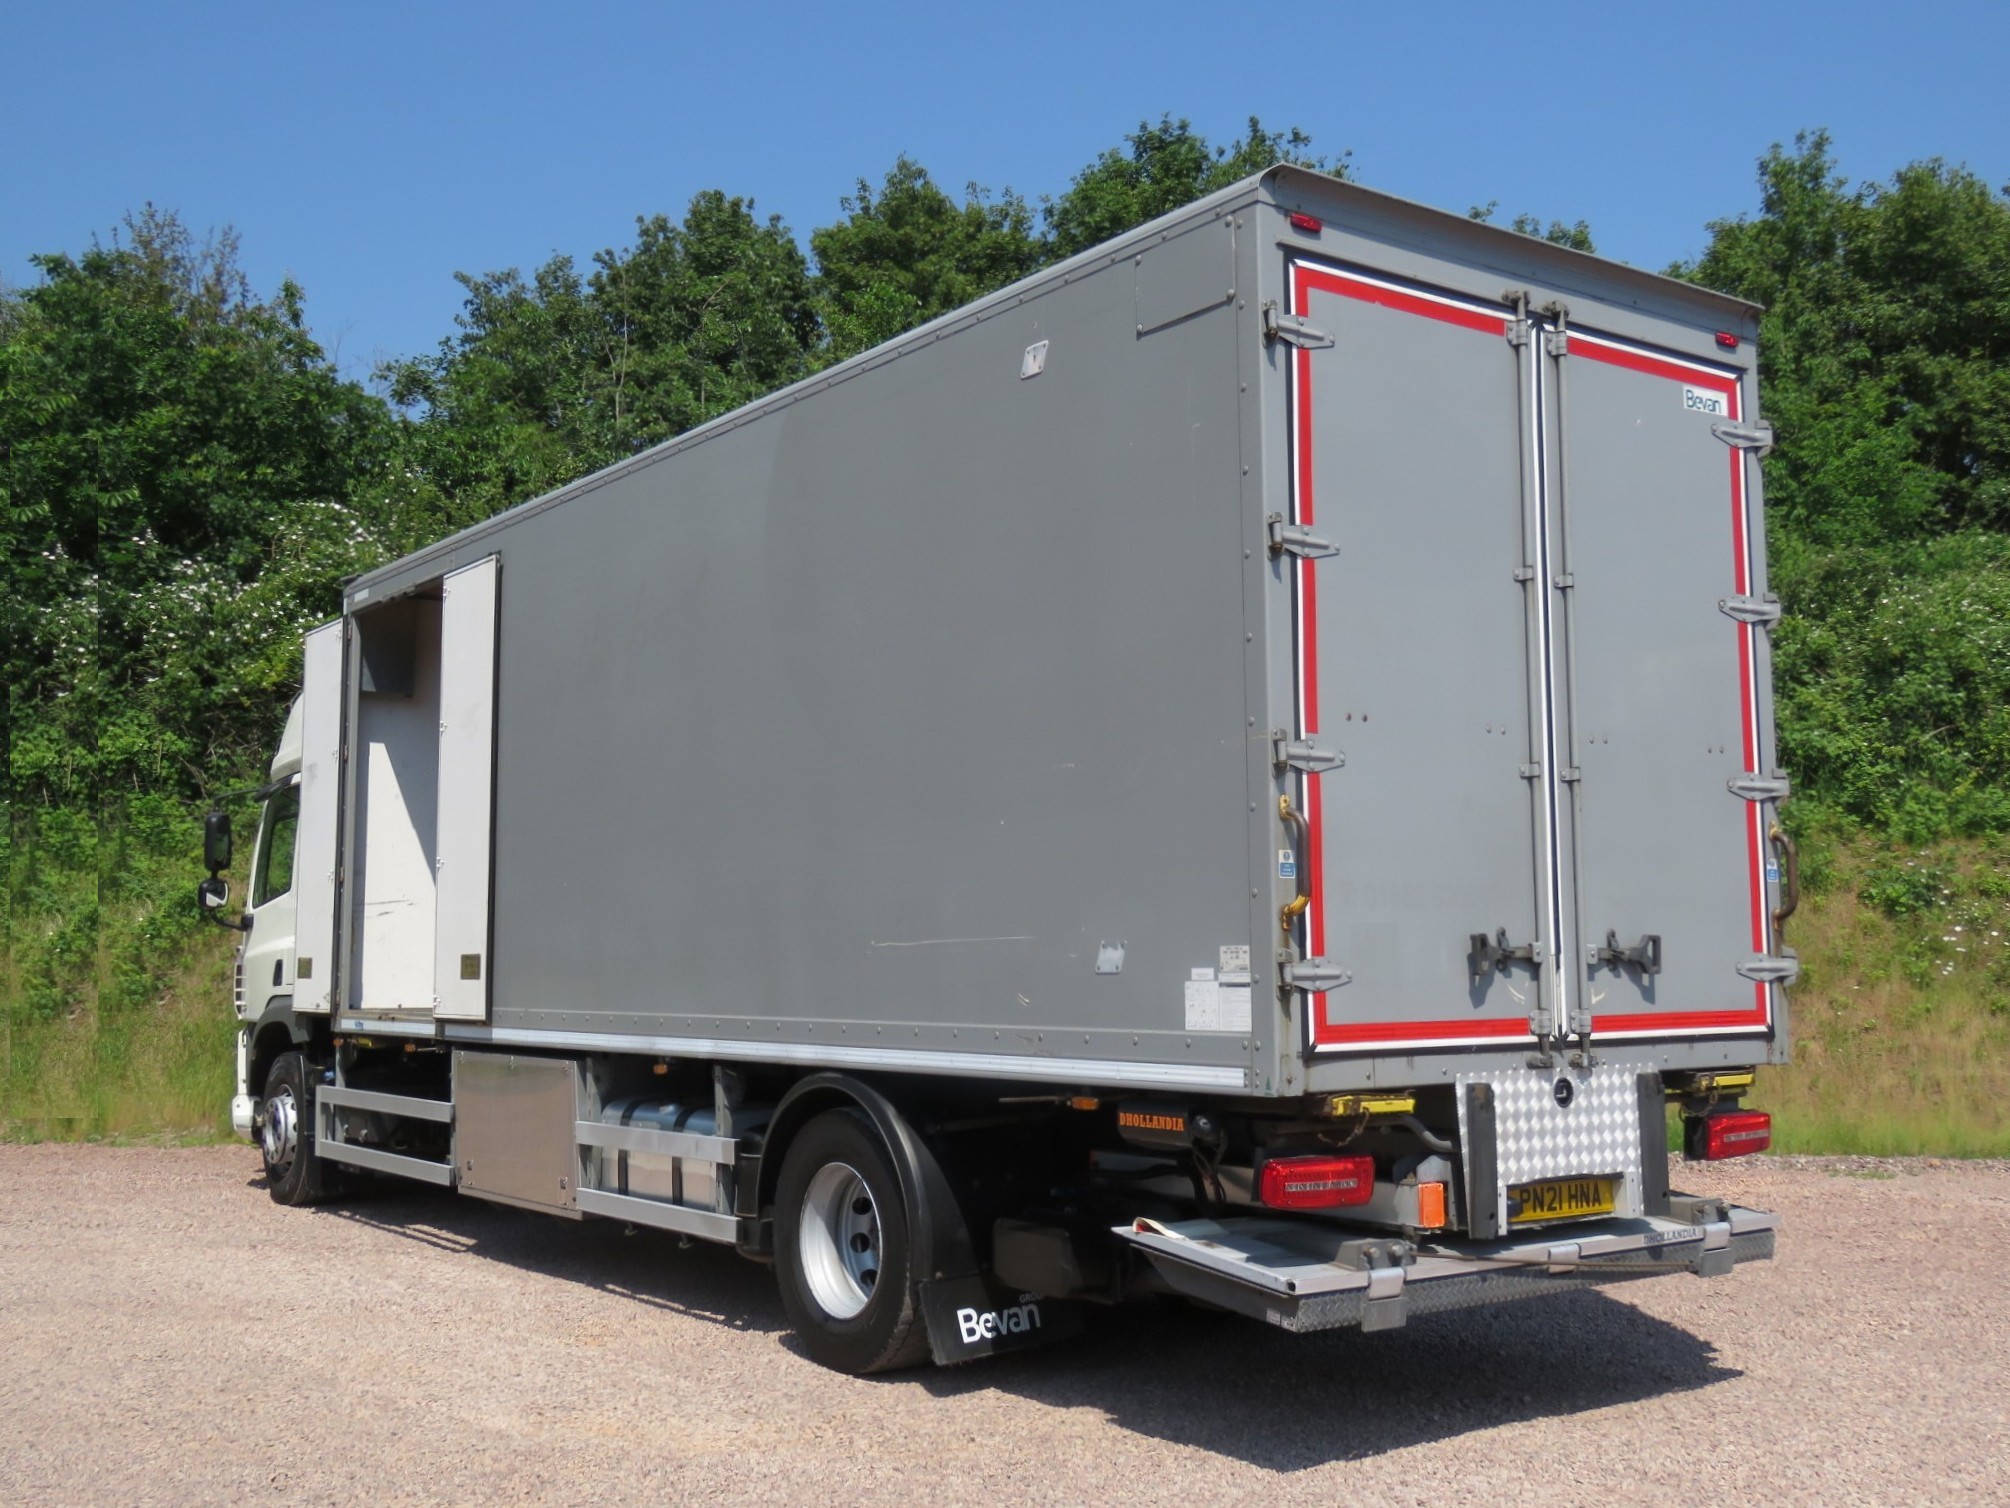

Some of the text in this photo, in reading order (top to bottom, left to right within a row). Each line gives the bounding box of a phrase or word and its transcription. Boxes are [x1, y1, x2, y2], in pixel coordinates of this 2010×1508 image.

[1686, 389, 1721, 414] Bevan
[1119, 1112, 1184, 1131] DHOLLANDIA
[1519, 1182, 1602, 1214] PN21 HNA
[1643, 1228, 1697, 1245] DHOLLANDIA
[1019, 1291, 1044, 1304] GROU
[957, 1303, 1041, 1344] Bevan
